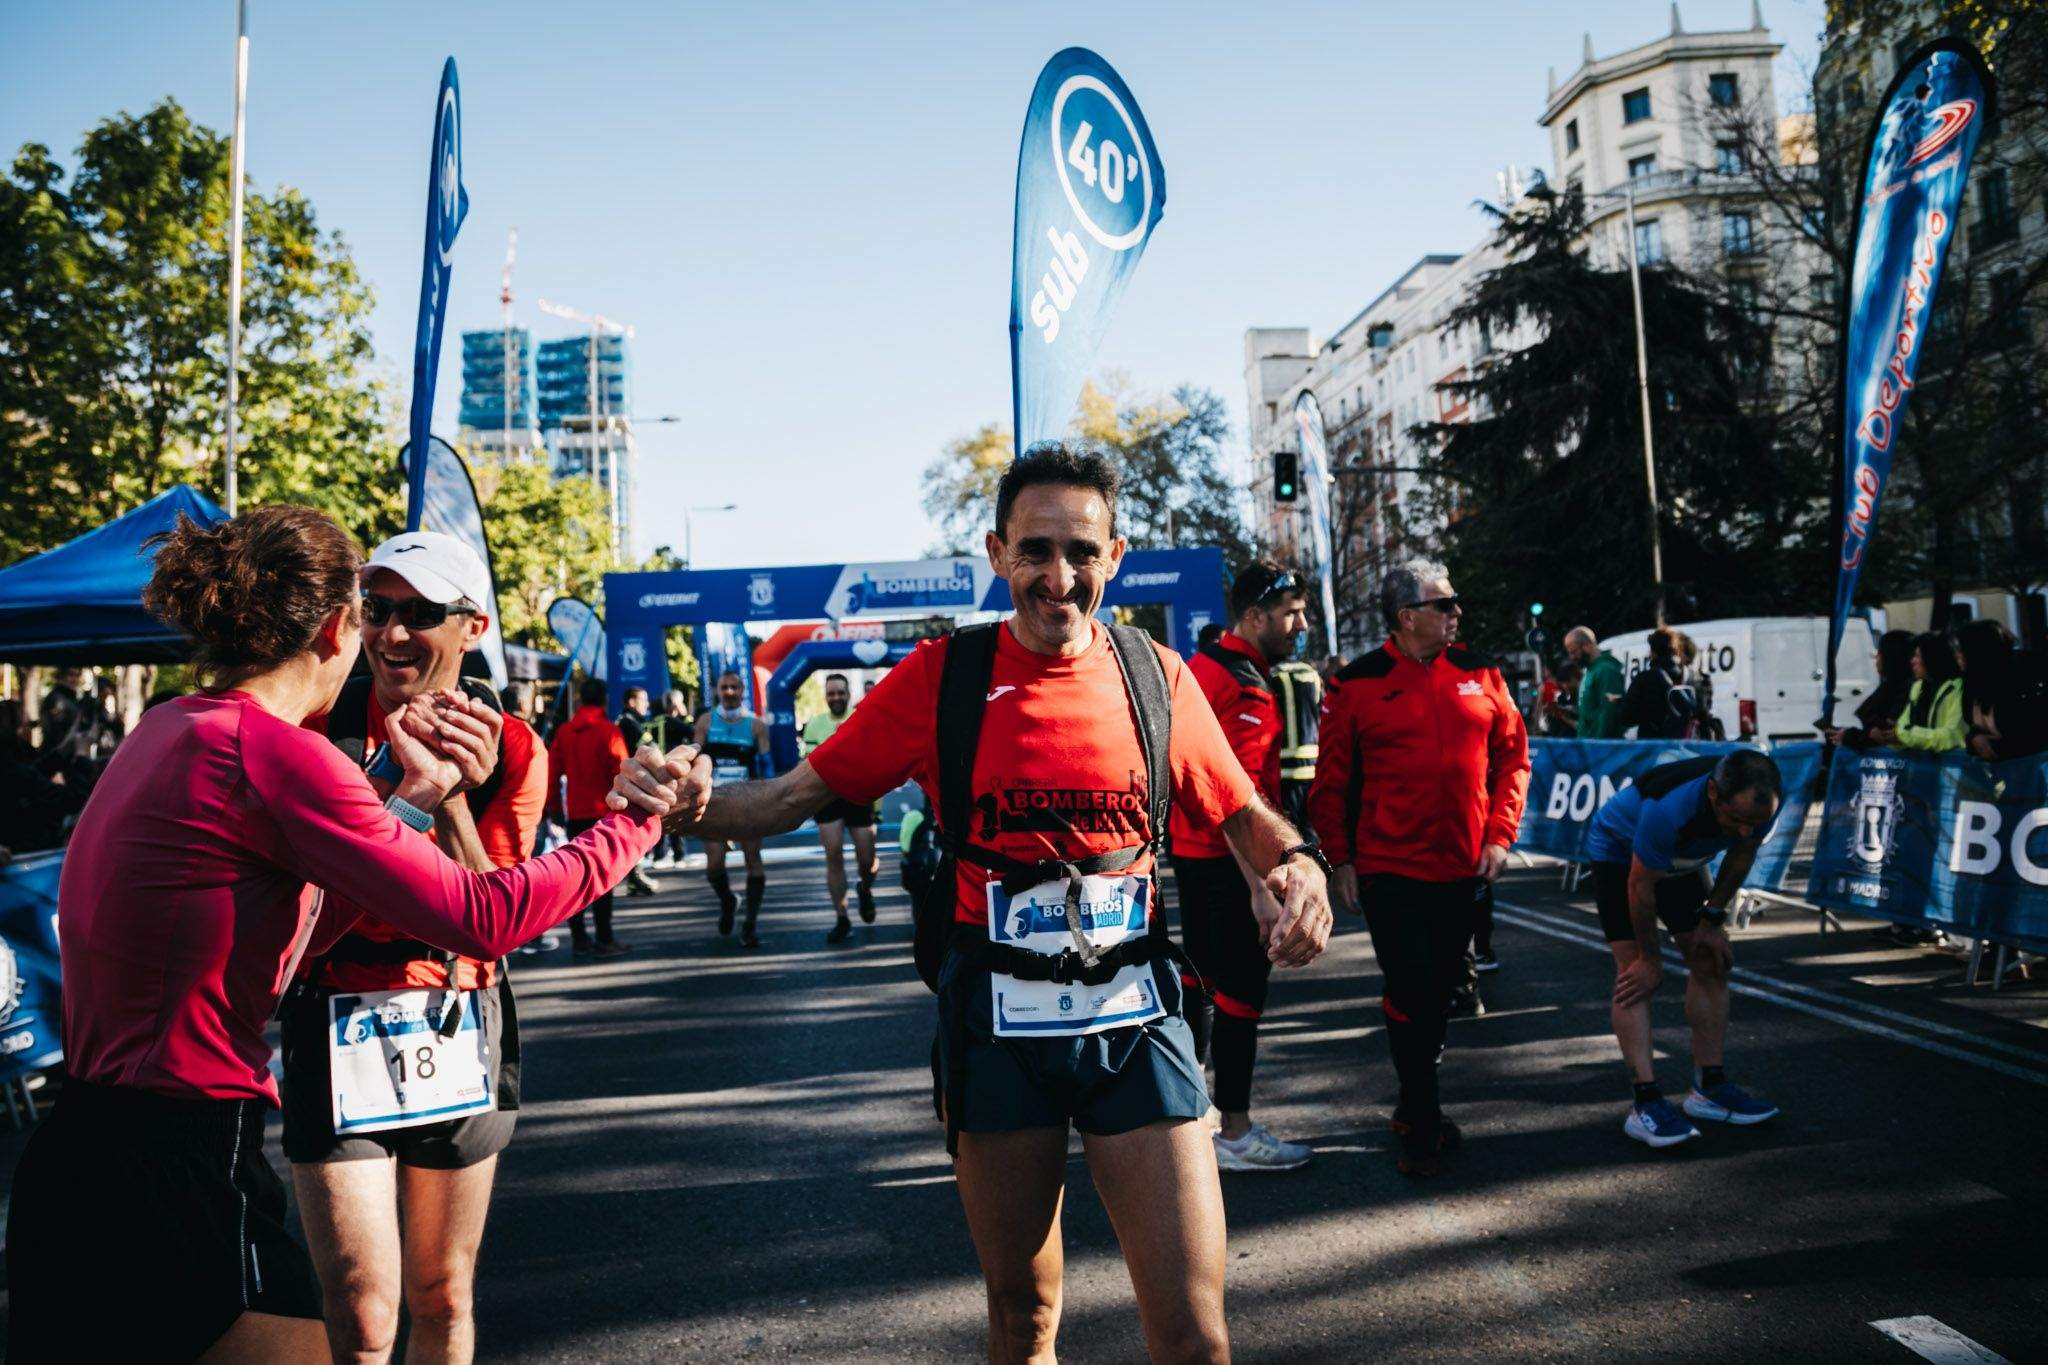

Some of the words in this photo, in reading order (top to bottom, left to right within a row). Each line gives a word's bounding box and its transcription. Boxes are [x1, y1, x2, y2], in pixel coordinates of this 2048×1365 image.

[1031, 225, 1090, 344] sub
[1857, 212, 1945, 450] Deportivo
[876, 577, 972, 594] BOMBEROS
[1013, 791, 1143, 811] BOMBERO
[1043, 900, 1122, 918] BOBEROS
[391, 1046, 435, 1083] 18
